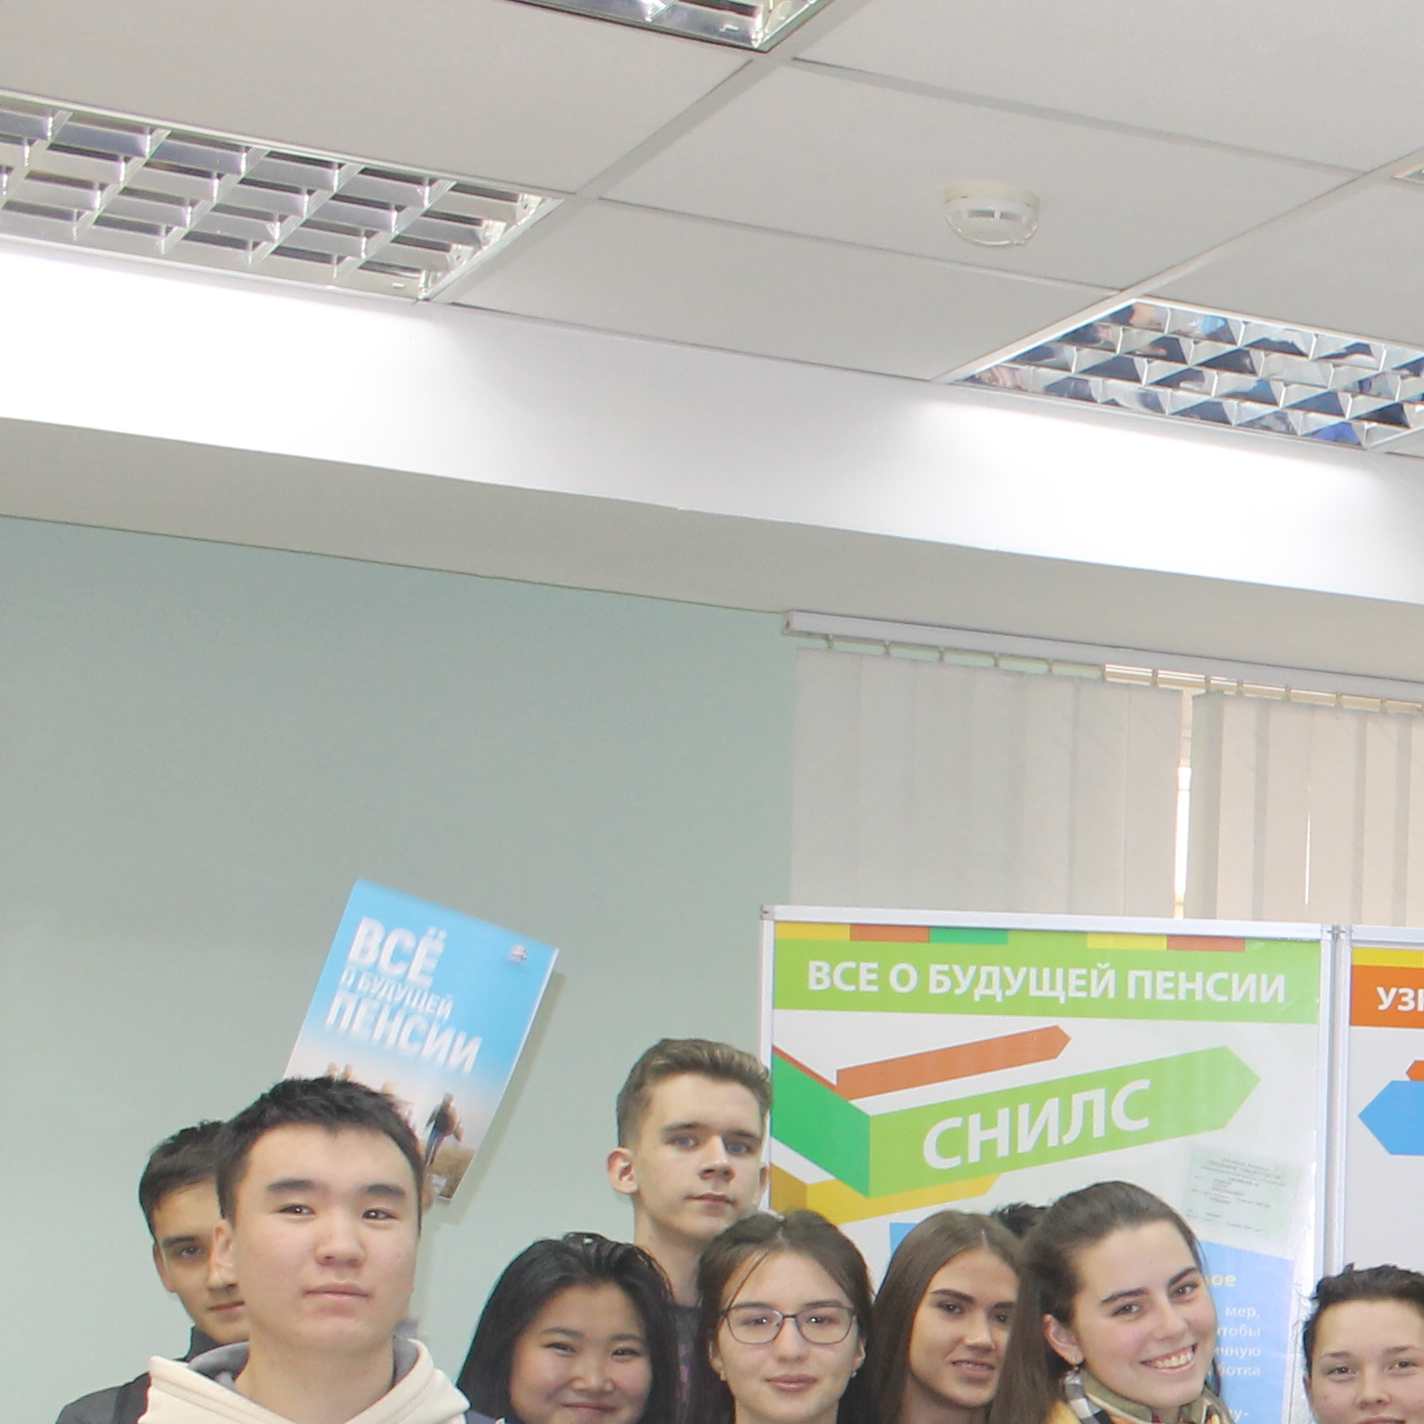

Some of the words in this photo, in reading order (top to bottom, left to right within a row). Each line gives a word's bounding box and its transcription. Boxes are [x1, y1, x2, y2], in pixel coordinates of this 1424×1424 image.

[347, 916, 447, 987] ВСЁ
[341, 968, 356, 985] О
[357, 974, 454, 1021] БУДУЩЕЙ
[808, 961, 878, 993] ВСЕ
[890, 962, 918, 994] О
[929, 962, 1117, 1002] БУДУЩЕЙ
[1126, 970, 1286, 1004] ПЕНСИИ
[324, 989, 482, 1075] ПЕНСИИ
[923, 1079, 1150, 1170] СНИЛС
[1217, 1326, 1261, 1337] тобы
[1225, 1306, 1260, 1319] мер,
